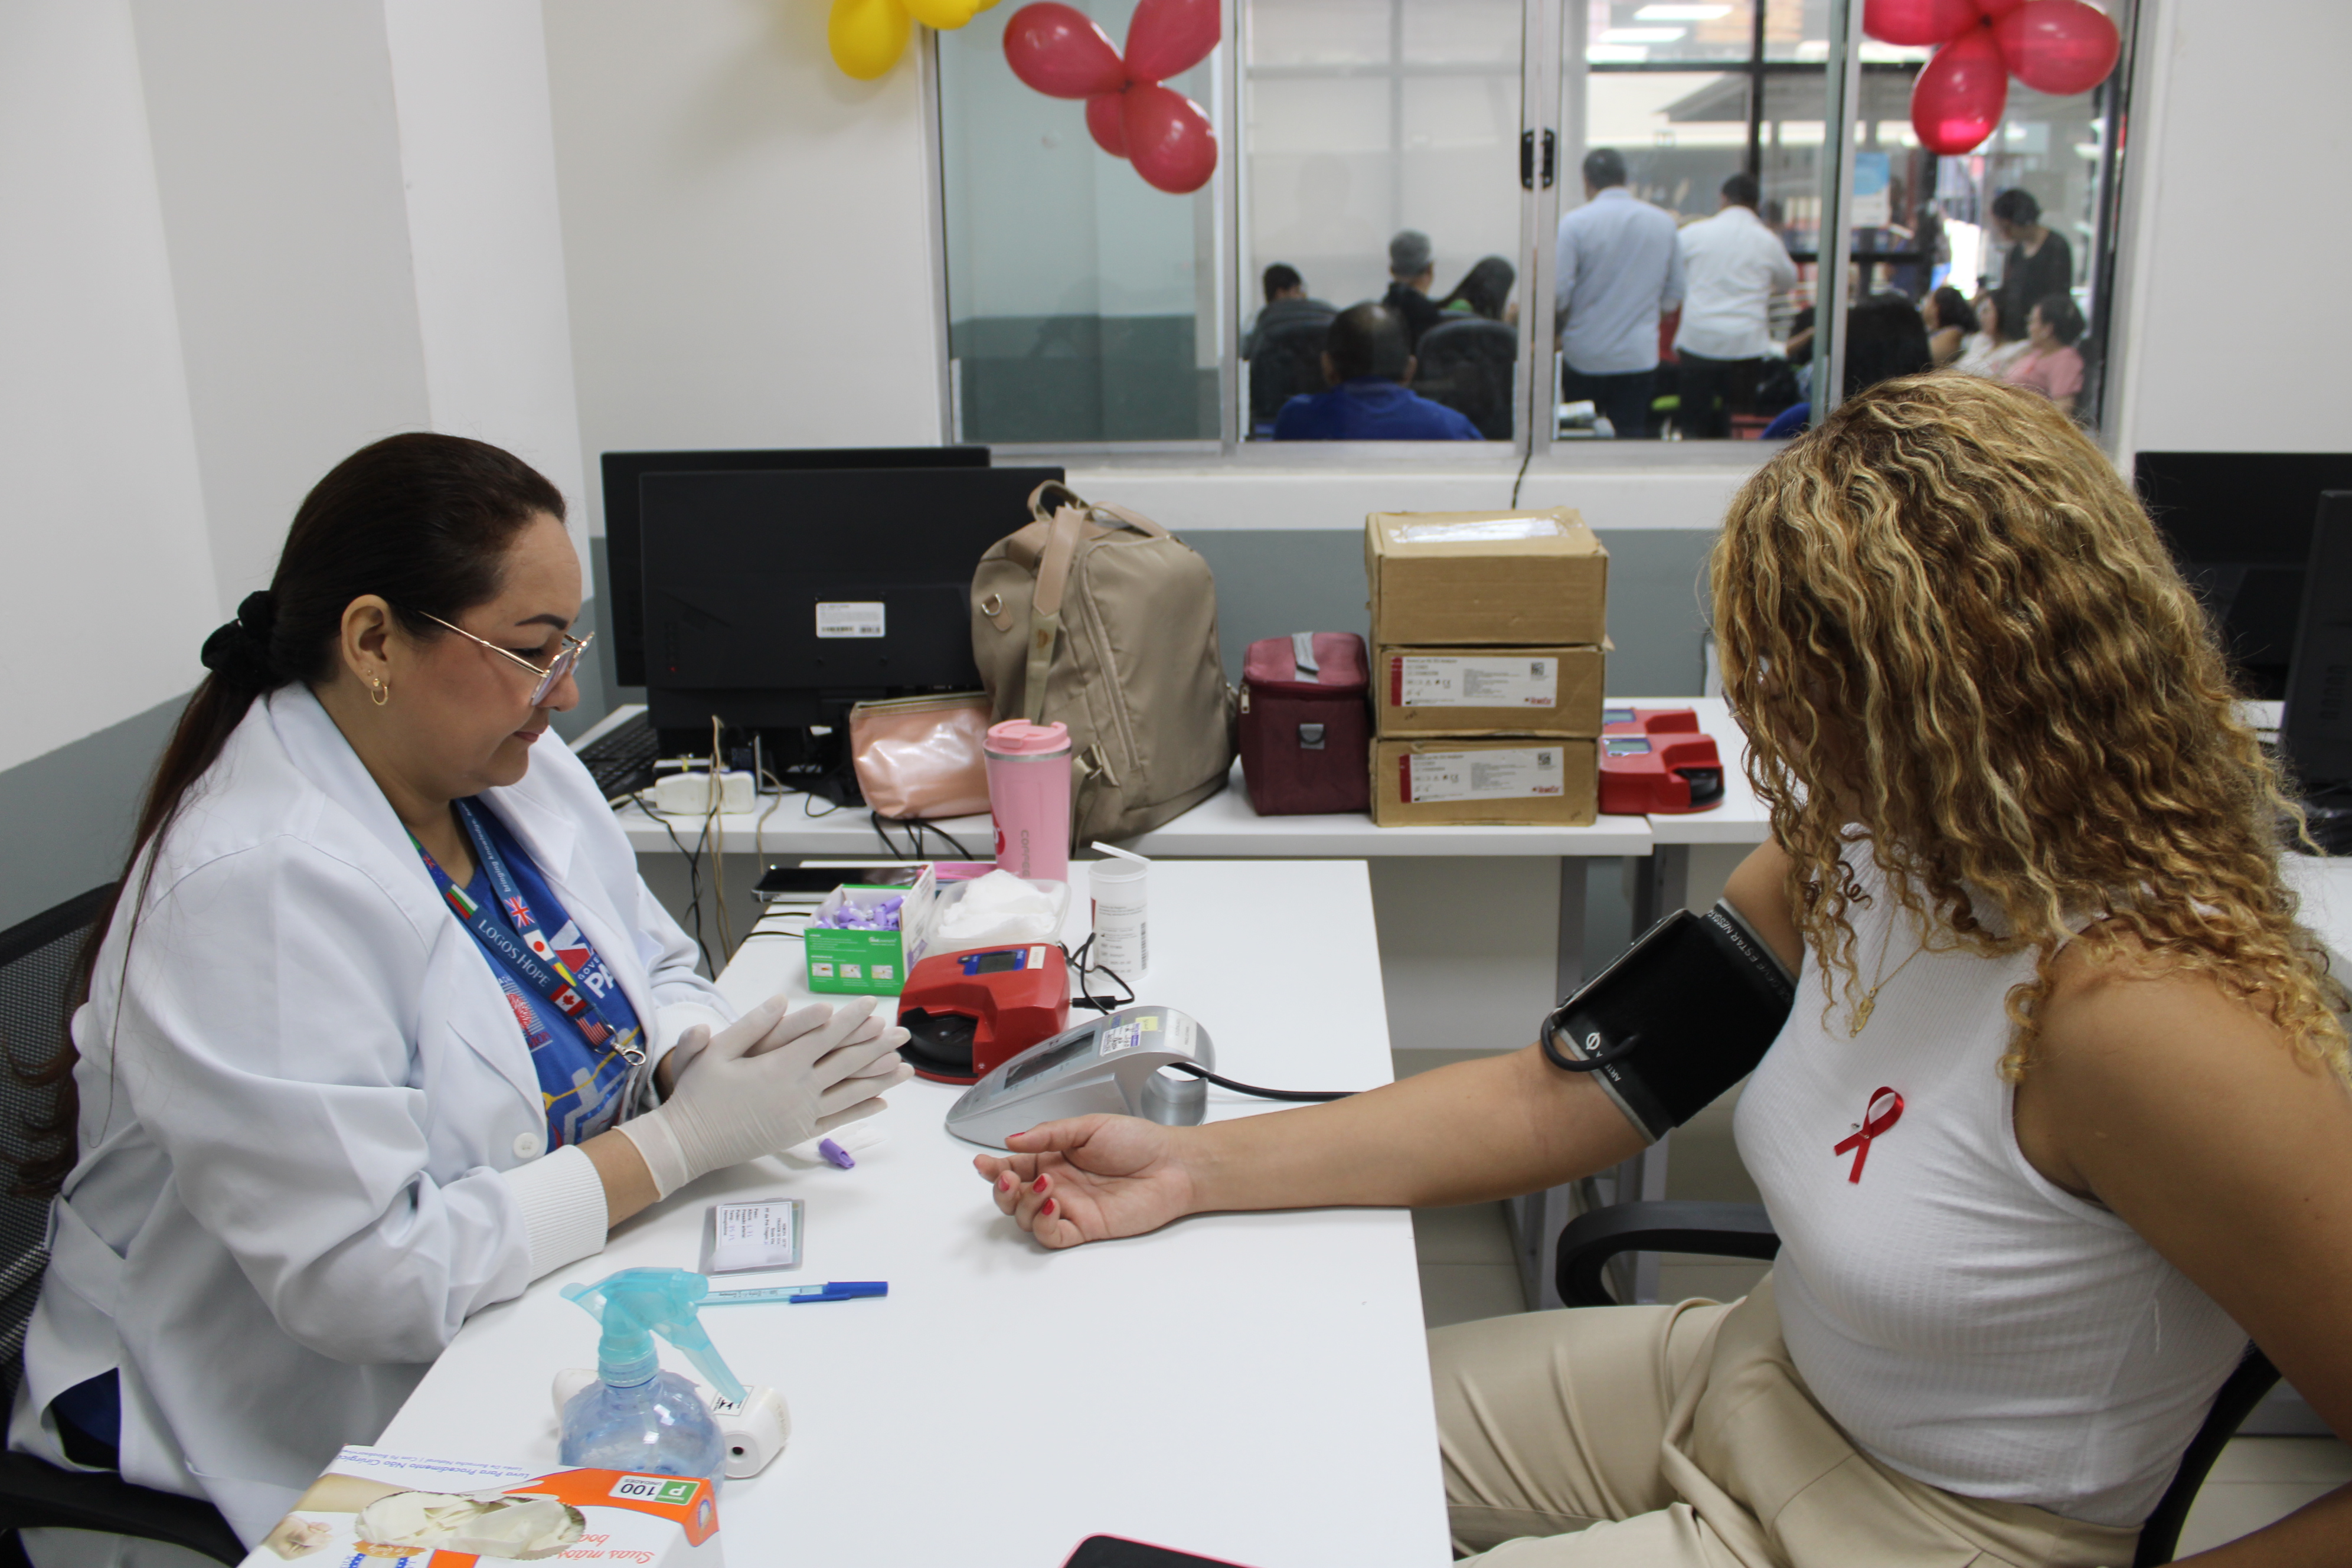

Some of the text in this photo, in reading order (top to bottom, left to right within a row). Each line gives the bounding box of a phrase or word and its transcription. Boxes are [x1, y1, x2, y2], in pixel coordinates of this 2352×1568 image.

[1021, 829, 1031, 878] COFFEE
[478, 919, 550, 988] LOGOS HOPE
[1732, 932, 1759, 963] ESTAR
[383, 1460, 406, 1469] Não
[424, 1458, 453, 1466] Natural
[456, 1461, 488, 1469] Borracha
[409, 1463, 476, 1475] Procedimento
[479, 1469, 504, 1478] Para
[506, 1471, 530, 1479] Luva
[623, 1478, 663, 1487] UNIDADES
[620, 1484, 656, 1497] 100
[668, 1485, 688, 1497] P
[557, 1549, 655, 1564] Suas mãos
